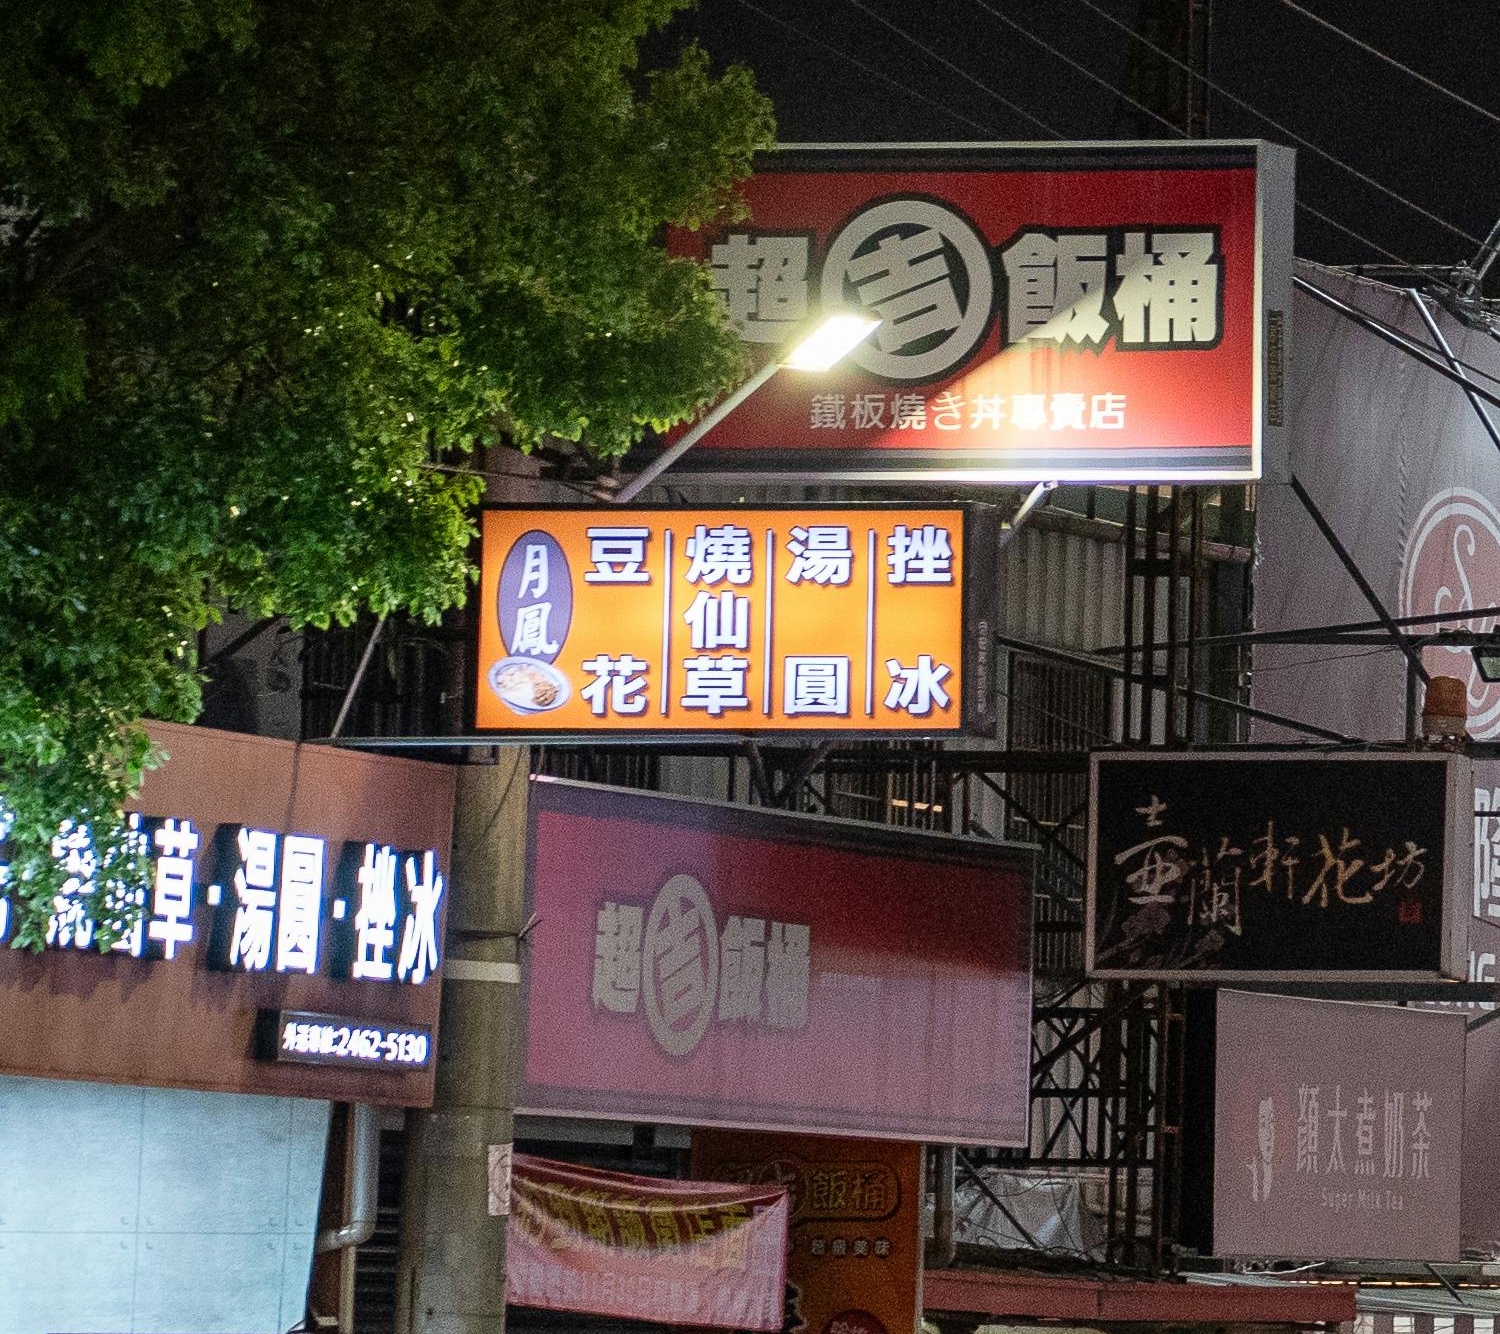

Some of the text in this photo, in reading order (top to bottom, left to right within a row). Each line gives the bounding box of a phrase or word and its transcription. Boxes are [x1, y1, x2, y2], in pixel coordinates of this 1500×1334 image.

[511, 540, 560, 658] 月鳳
[581, 525, 651, 716] 豆花
[681, 523, 753, 715] 燒仙草
[785, 525, 853, 717] 湯圓
[884, 525, 954, 714] 挫冰
